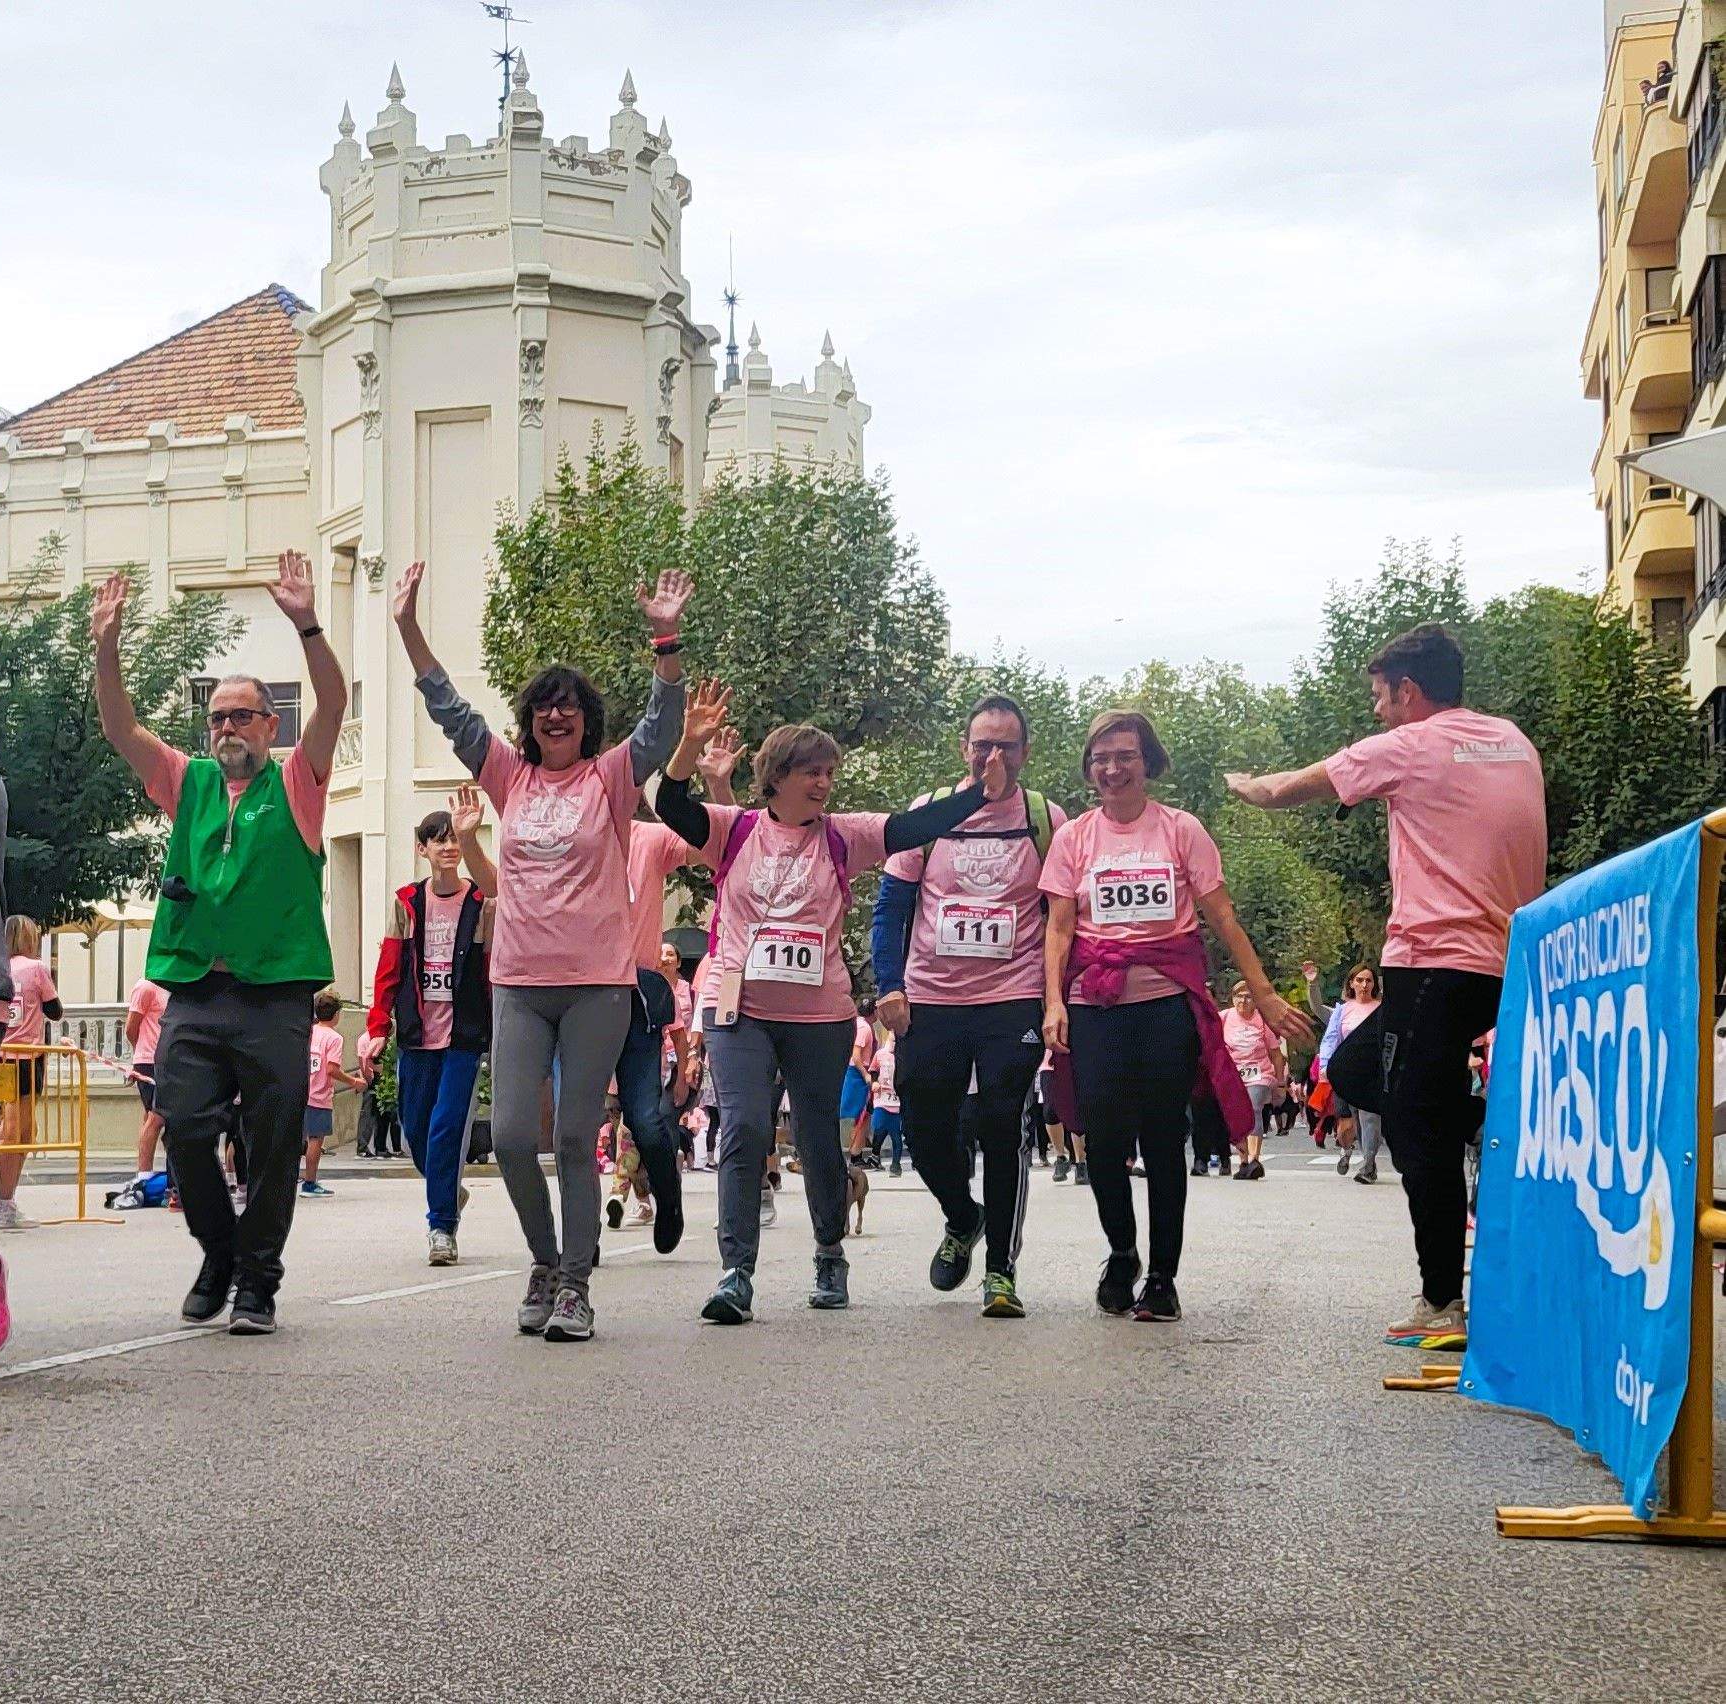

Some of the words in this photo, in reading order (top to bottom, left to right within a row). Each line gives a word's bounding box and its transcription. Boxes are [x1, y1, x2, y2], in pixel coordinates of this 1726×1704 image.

[1099, 882, 1169, 909] 3036
[953, 920, 999, 944] 111
[763, 943, 812, 969] 110
